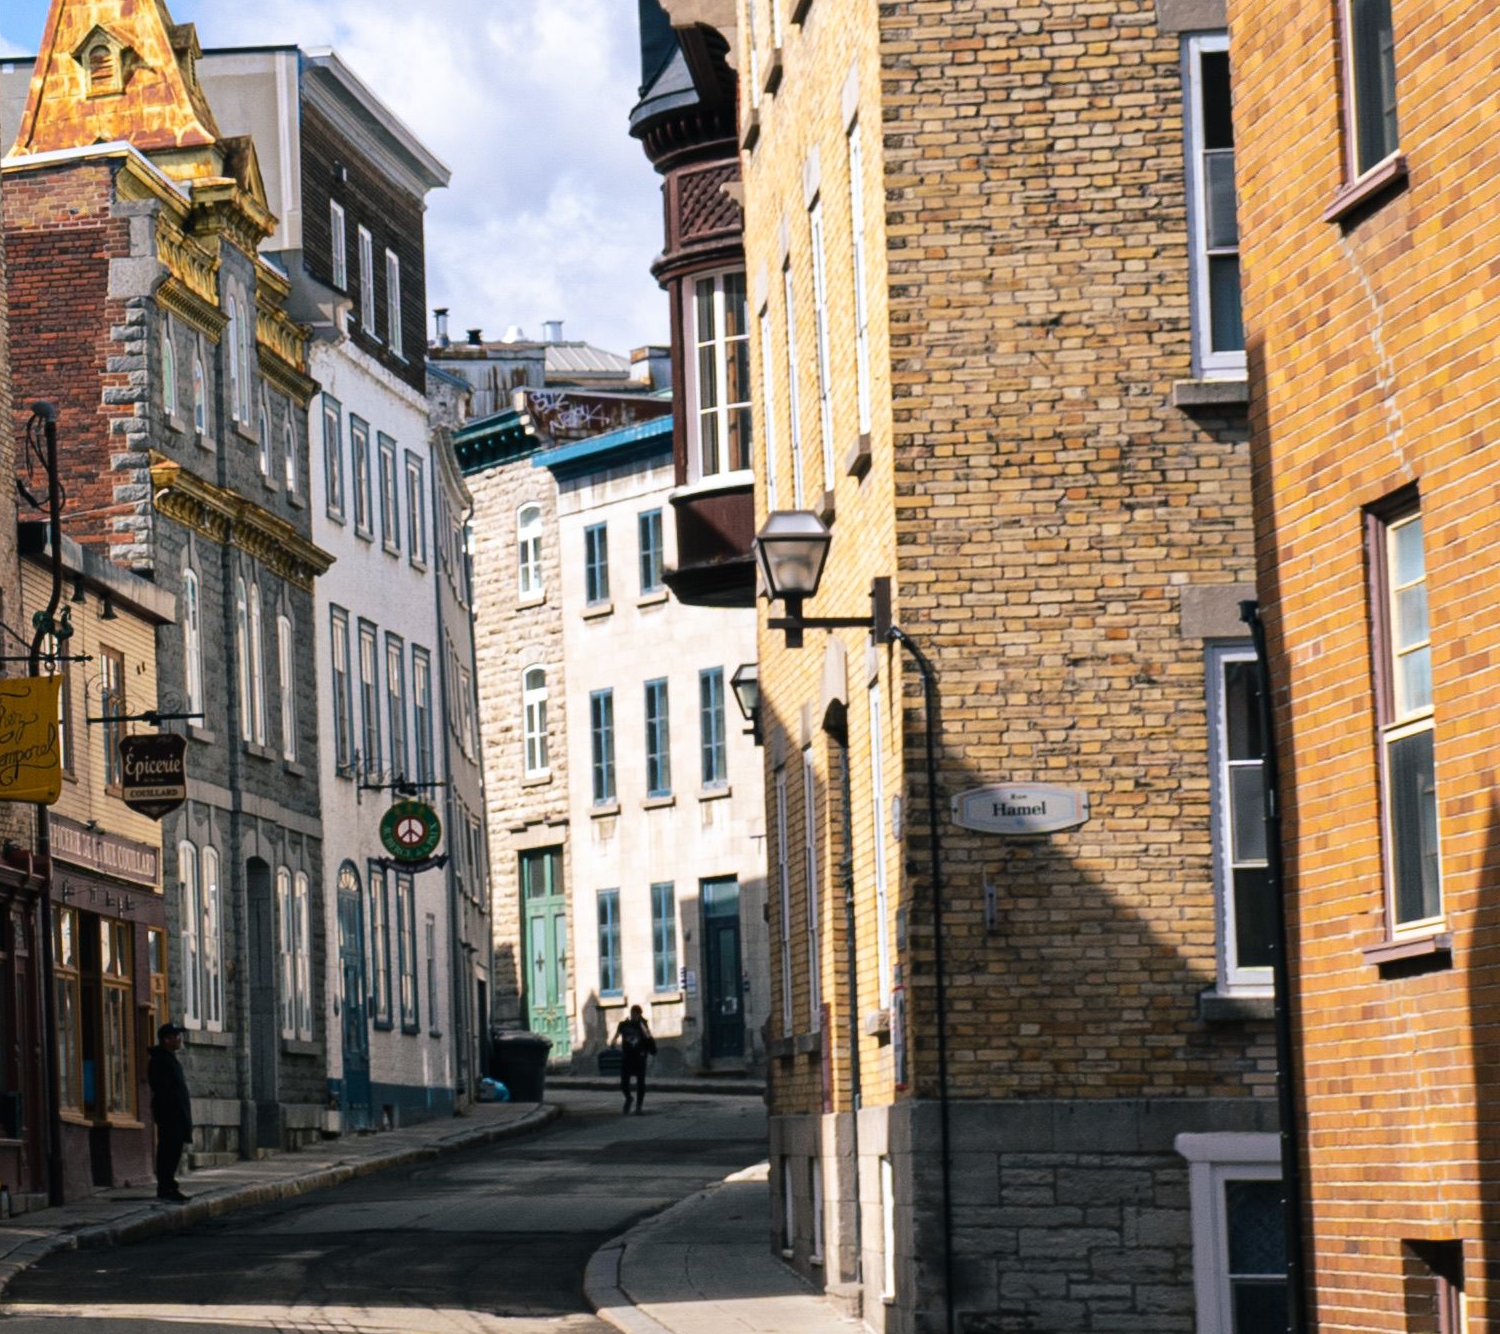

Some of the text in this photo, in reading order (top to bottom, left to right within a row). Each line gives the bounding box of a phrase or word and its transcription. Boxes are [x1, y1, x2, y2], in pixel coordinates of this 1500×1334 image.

[125, 746, 181, 782] Épicerie
[130, 788, 179, 798] COUILLARD
[992, 801, 1046, 816] Hamel
